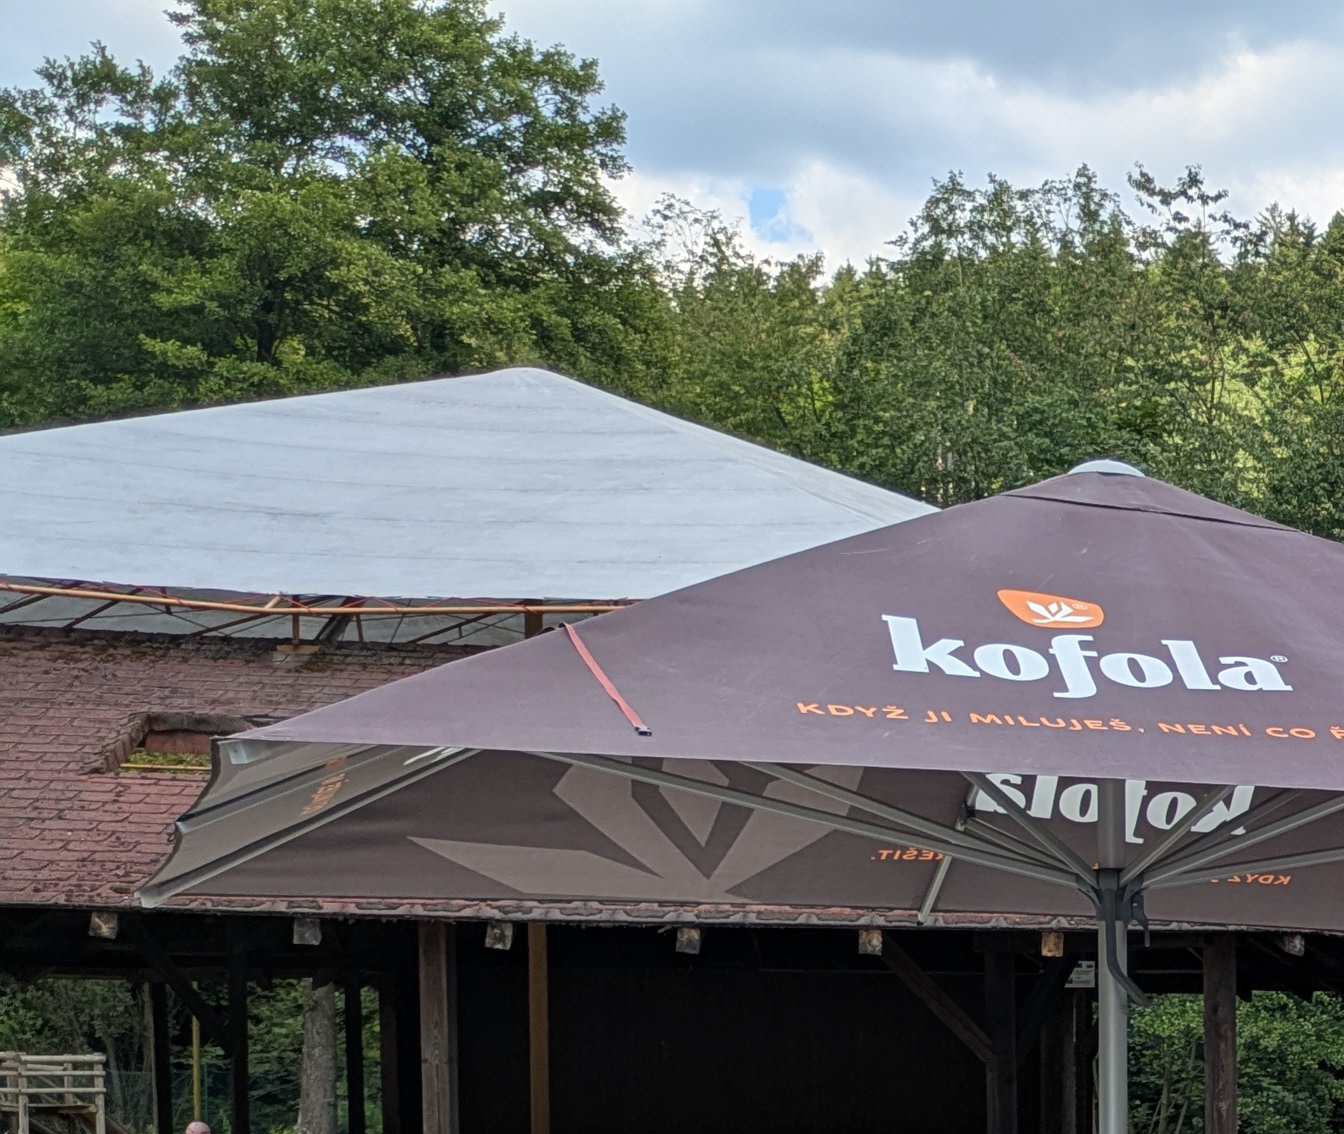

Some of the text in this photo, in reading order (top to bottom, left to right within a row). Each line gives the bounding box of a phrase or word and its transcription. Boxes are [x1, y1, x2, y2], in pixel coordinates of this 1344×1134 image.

[881, 613, 1294, 699] kofola
[796, 702, 909, 720] KDYŽ
[925, 710, 952, 723] JI
[969, 712, 1146, 734] MILUJEŠ,
[1159, 722, 1250, 738] NENÍ
[1265, 726, 1316, 740] CO
